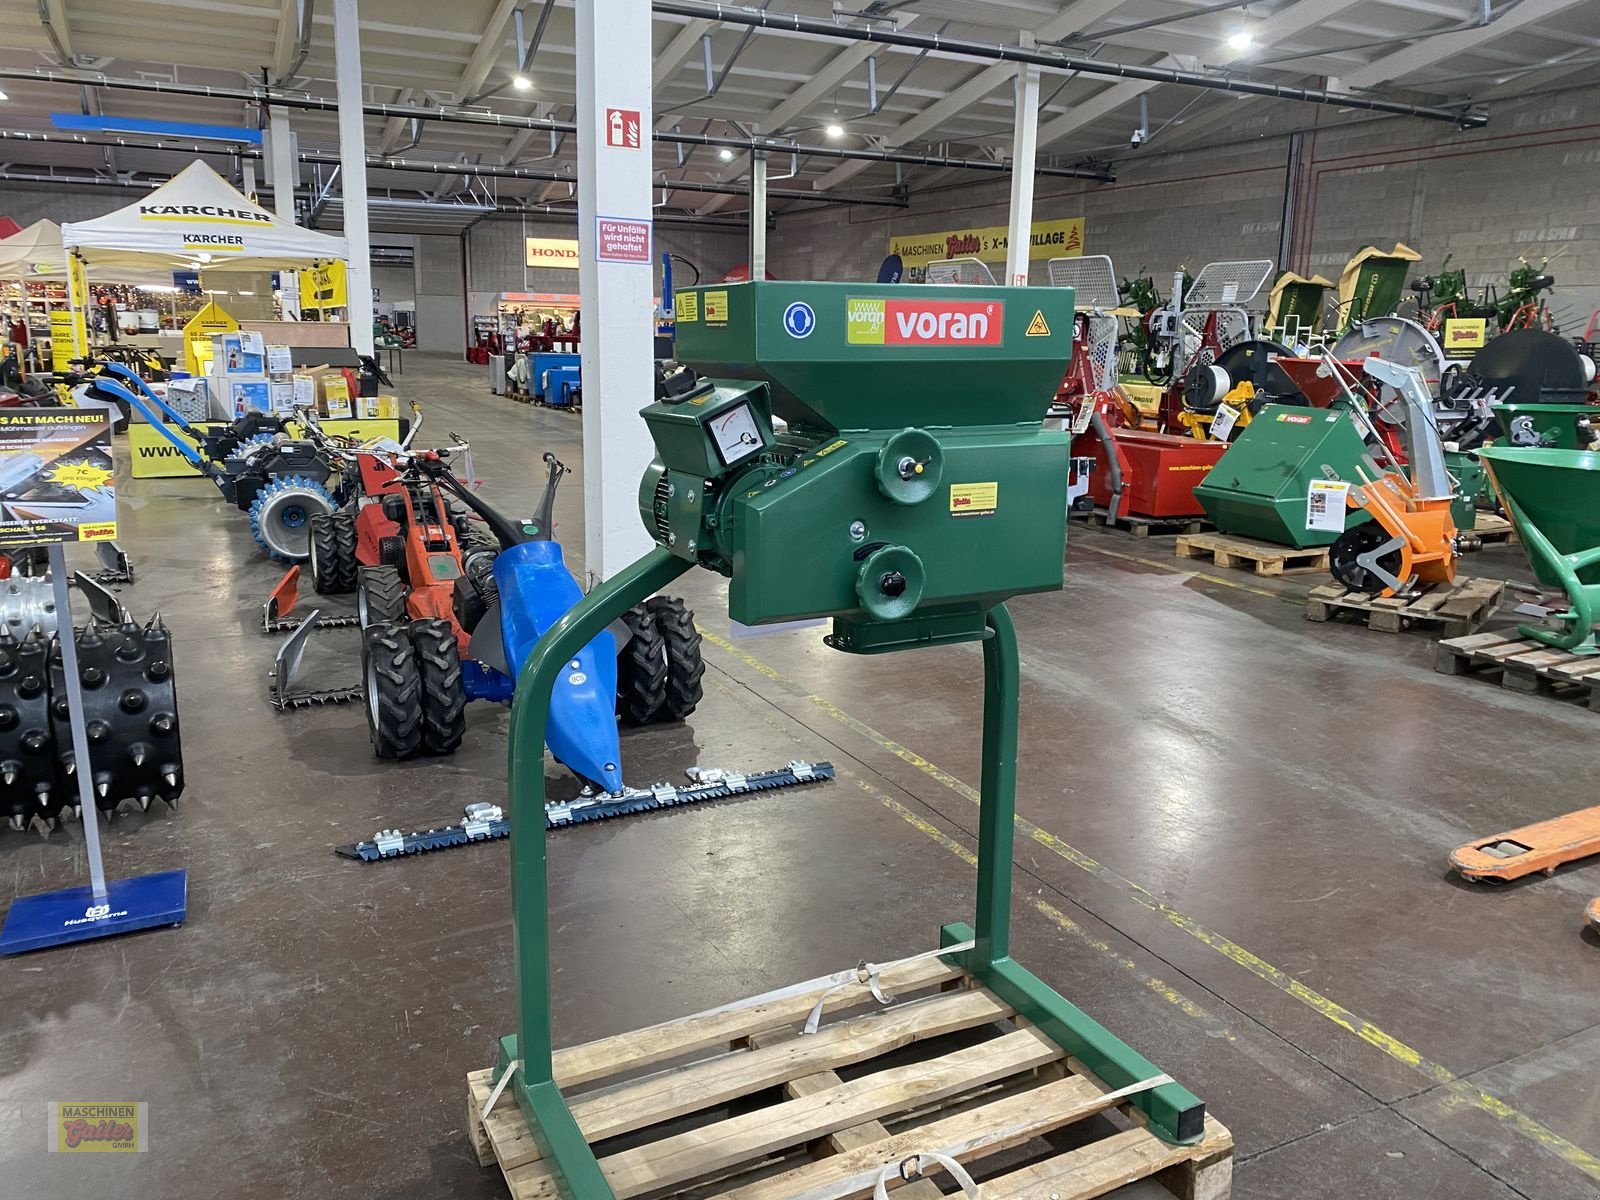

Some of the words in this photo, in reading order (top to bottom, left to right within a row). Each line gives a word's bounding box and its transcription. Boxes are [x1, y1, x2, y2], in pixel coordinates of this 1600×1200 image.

[140, 205, 271, 222] KÄRCHER
[602, 224, 616, 232] Für
[618, 225, 646, 235] Unfälle
[183, 234, 244, 244] KÄRCHER
[603, 233, 623, 242] wird
[623, 235, 645, 243] nicht
[606, 242, 642, 252] gehaftet
[902, 244, 943, 256] MASCHINEN
[531, 248, 579, 258] HOND
[896, 312, 988, 339] voran
[11, 416, 34, 424] ALT
[35, 415, 74, 424] MACH
[75, 414, 104, 422] NEU!
[571, 675, 585, 683] BCS
[64, 910, 128, 927] Husqvarna
